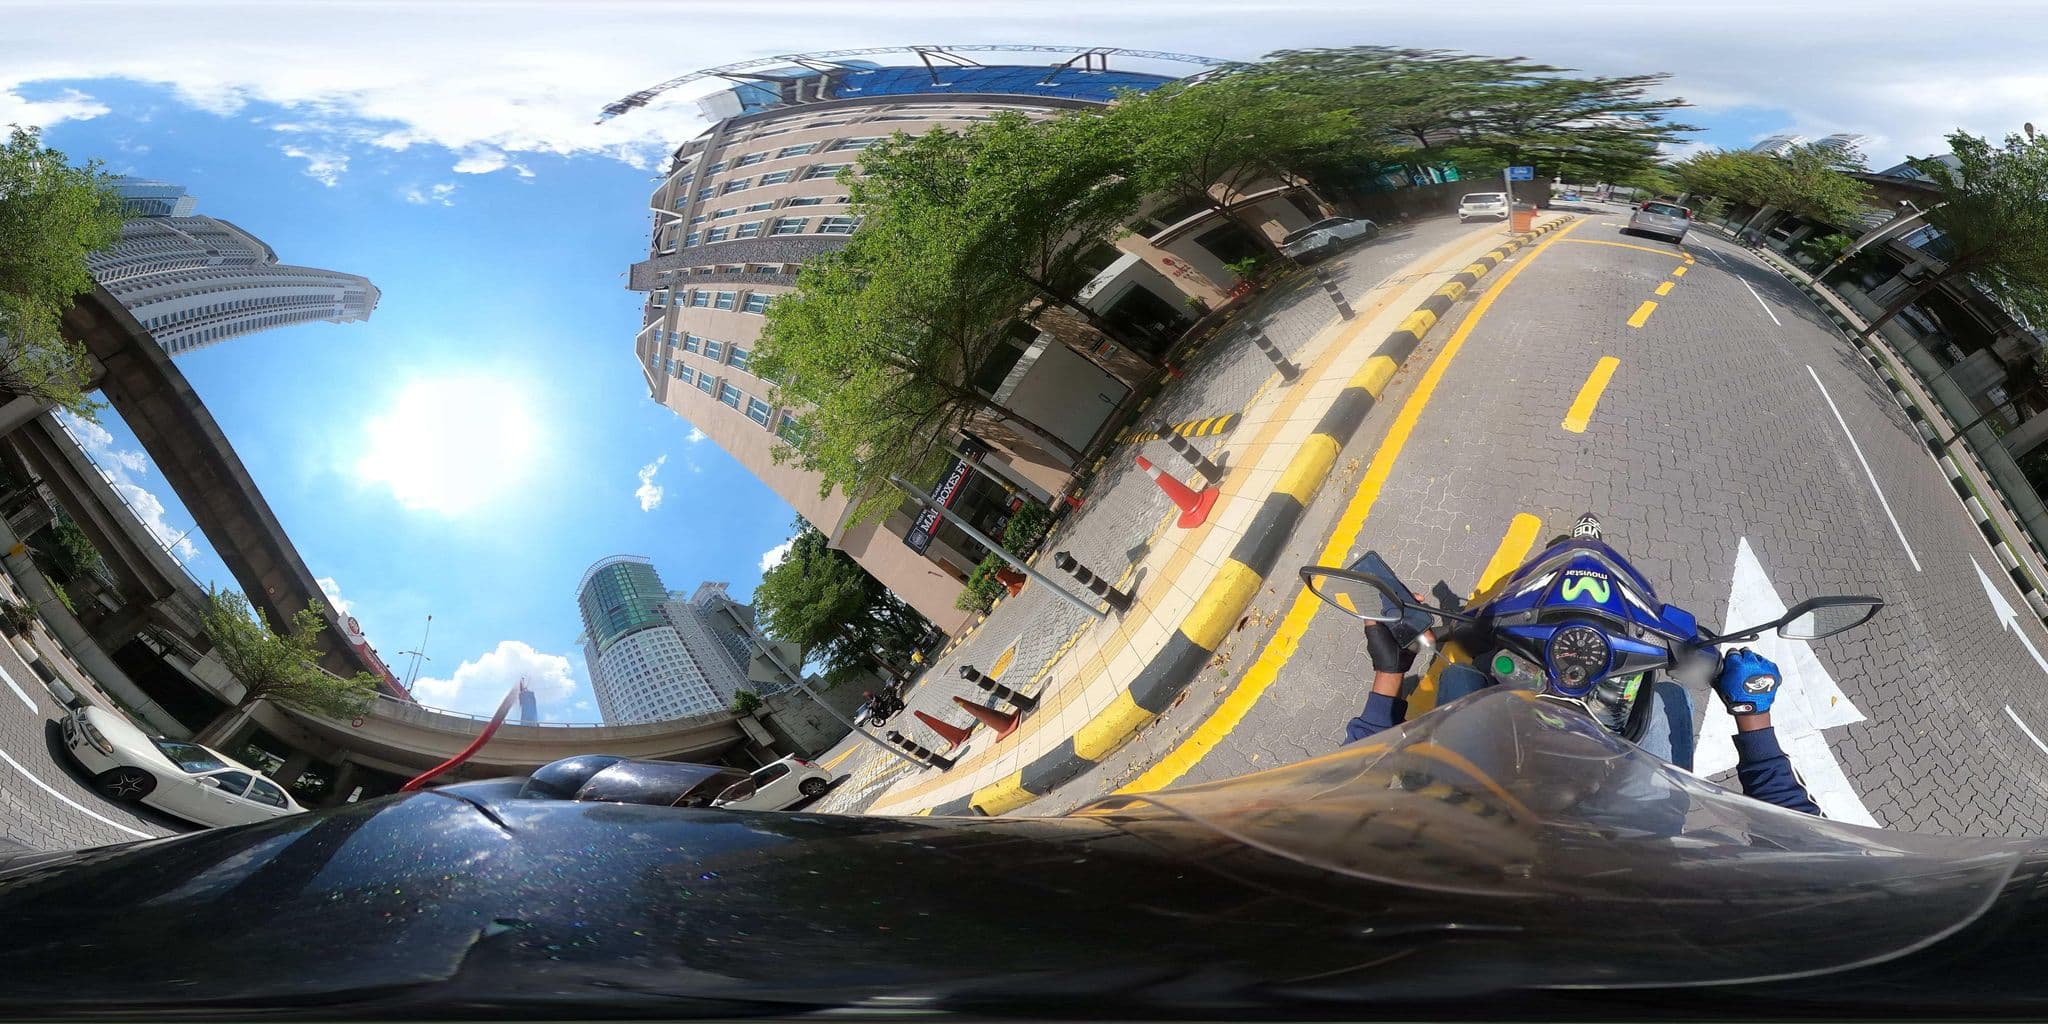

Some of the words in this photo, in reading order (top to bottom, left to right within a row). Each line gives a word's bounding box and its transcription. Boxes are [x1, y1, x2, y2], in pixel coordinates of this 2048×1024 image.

[920, 507, 939, 532] MAI
[936, 472, 961, 506] BOXES
[1565, 570, 1608, 580] movistar
